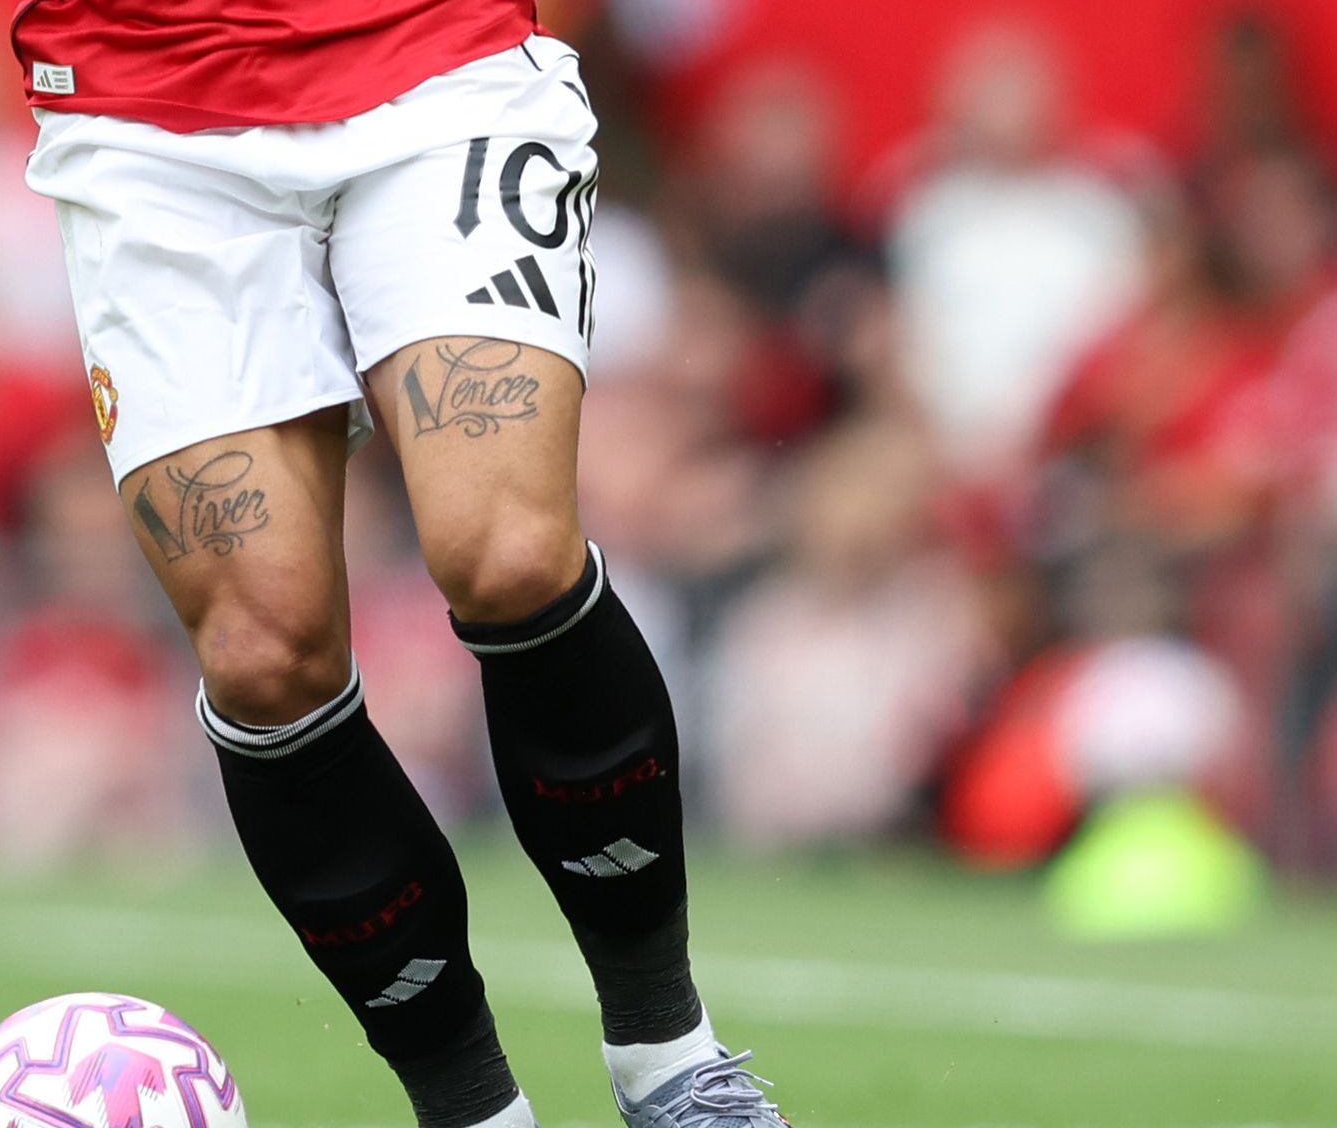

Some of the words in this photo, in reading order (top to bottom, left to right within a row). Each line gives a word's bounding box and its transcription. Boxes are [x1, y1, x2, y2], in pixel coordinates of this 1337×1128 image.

[453, 136, 583, 250] 10
[402, 338, 540, 439] Vencer
[133, 450, 270, 564] Viver
